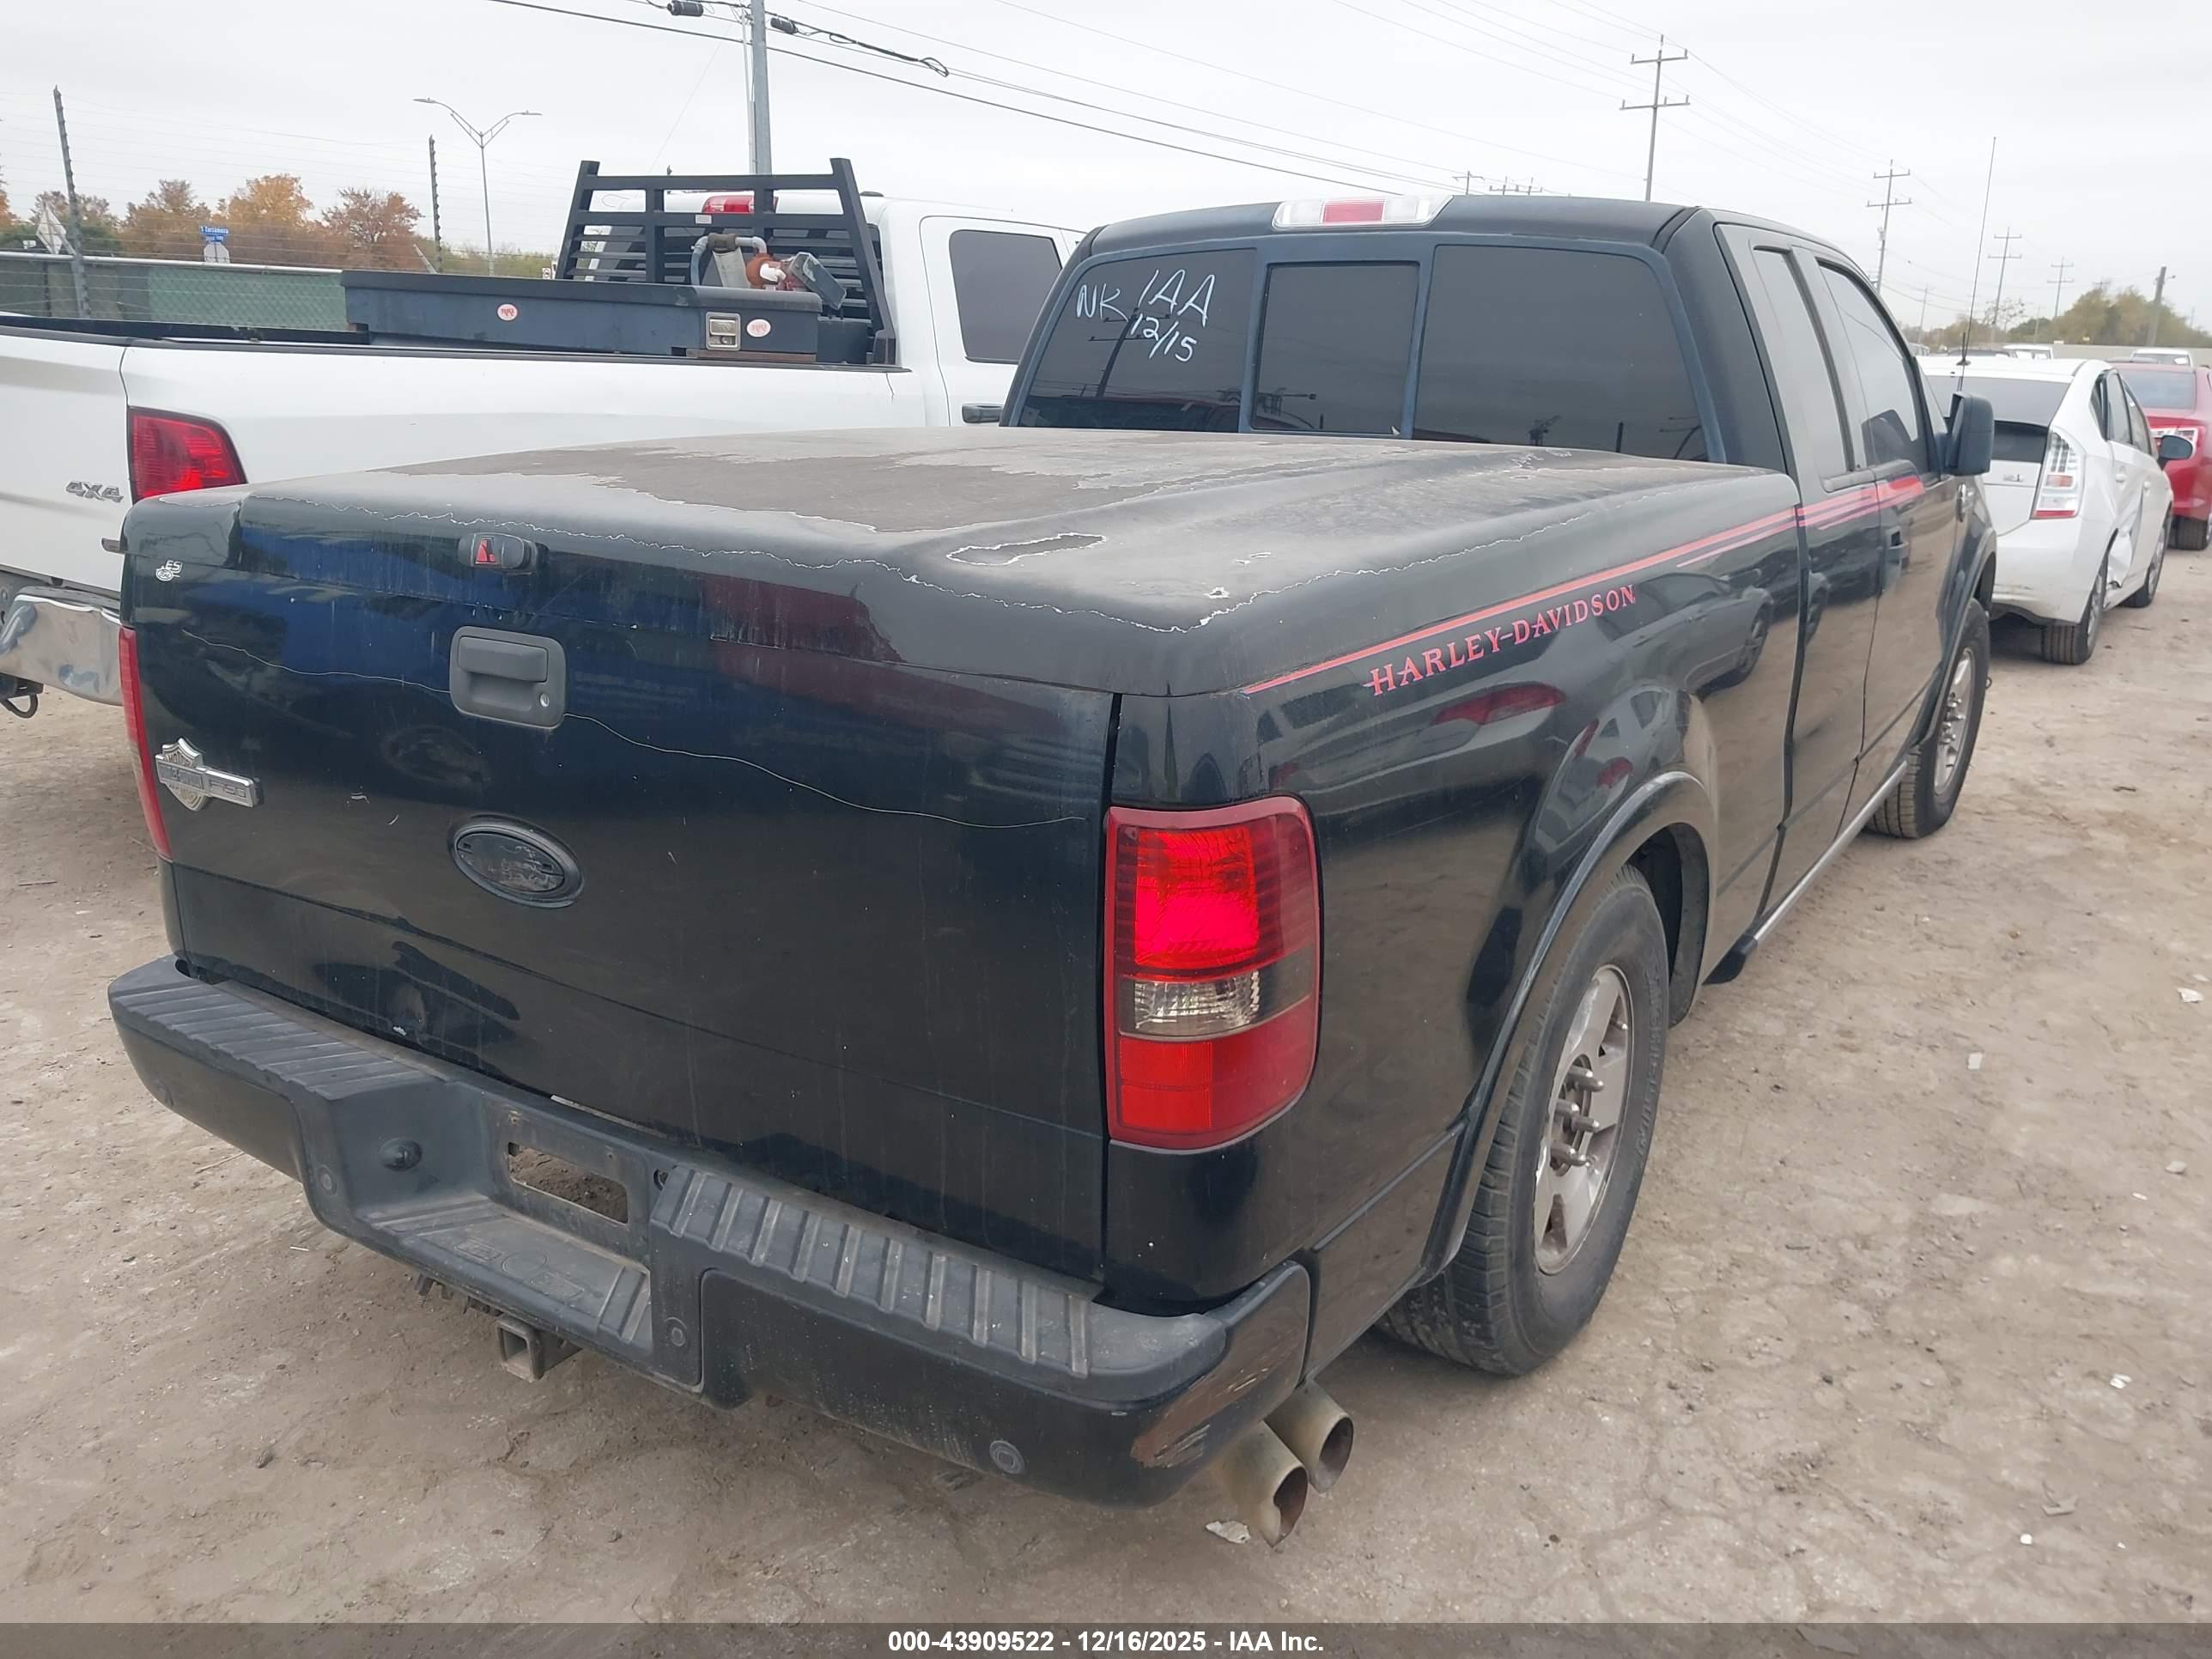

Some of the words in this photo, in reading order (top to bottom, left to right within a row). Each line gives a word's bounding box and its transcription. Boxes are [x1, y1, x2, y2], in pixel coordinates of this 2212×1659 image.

[1076, 283, 1129, 323] NK
[1130, 313, 1198, 362] 12/15
[1363, 584, 1637, 696] HARLEY-DAVIDSON
